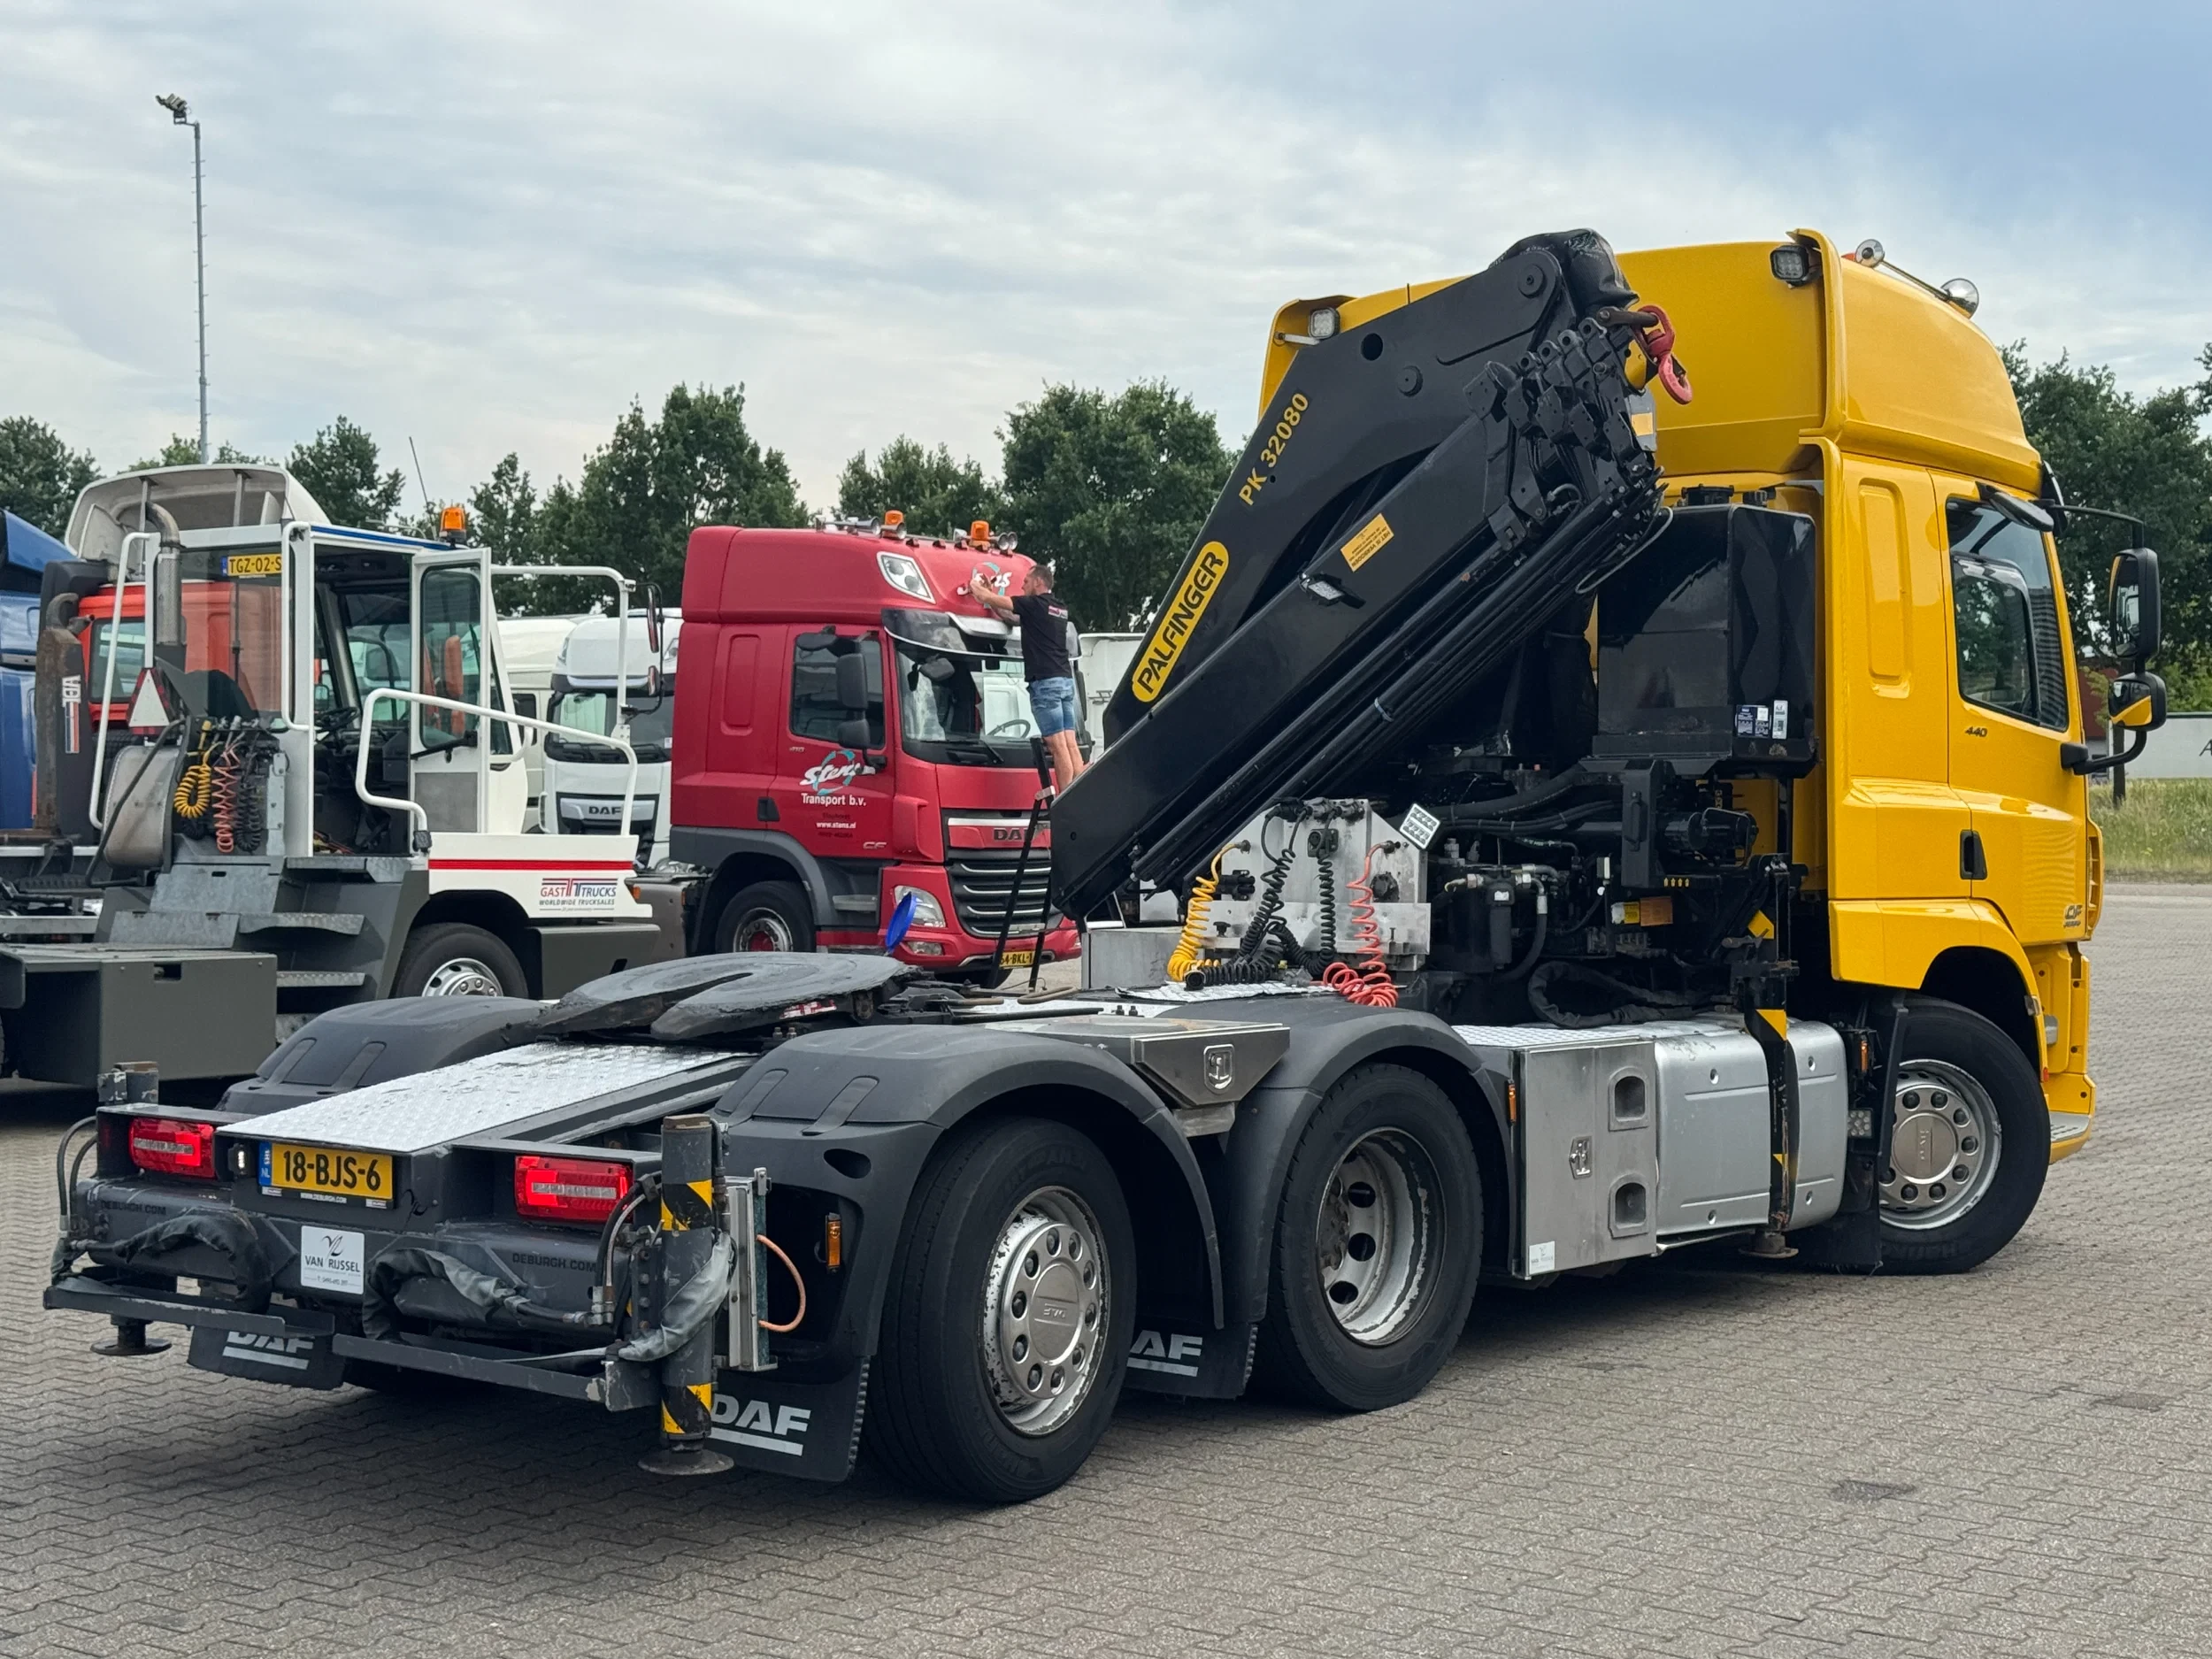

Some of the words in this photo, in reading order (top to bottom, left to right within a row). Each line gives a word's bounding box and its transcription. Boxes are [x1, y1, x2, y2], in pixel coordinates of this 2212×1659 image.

[1239, 467, 1267, 505] PK
[1261, 393, 1308, 467] 32080
[229, 556, 281, 573] TGZ-02-S
[1137, 551, 1224, 694] PALFINGER
[1964, 726, 1988, 737] 440
[801, 793, 846, 807] Transport
[849, 795, 866, 806] b.v.
[588, 805, 622, 815] DAF
[994, 826, 1029, 841] DA
[283, 1150, 381, 1191] 18-BJS-6
[305, 1255, 324, 1268] VAN
[1129, 1329, 1203, 1360] AF
[710, 1393, 812, 1435] DAF
